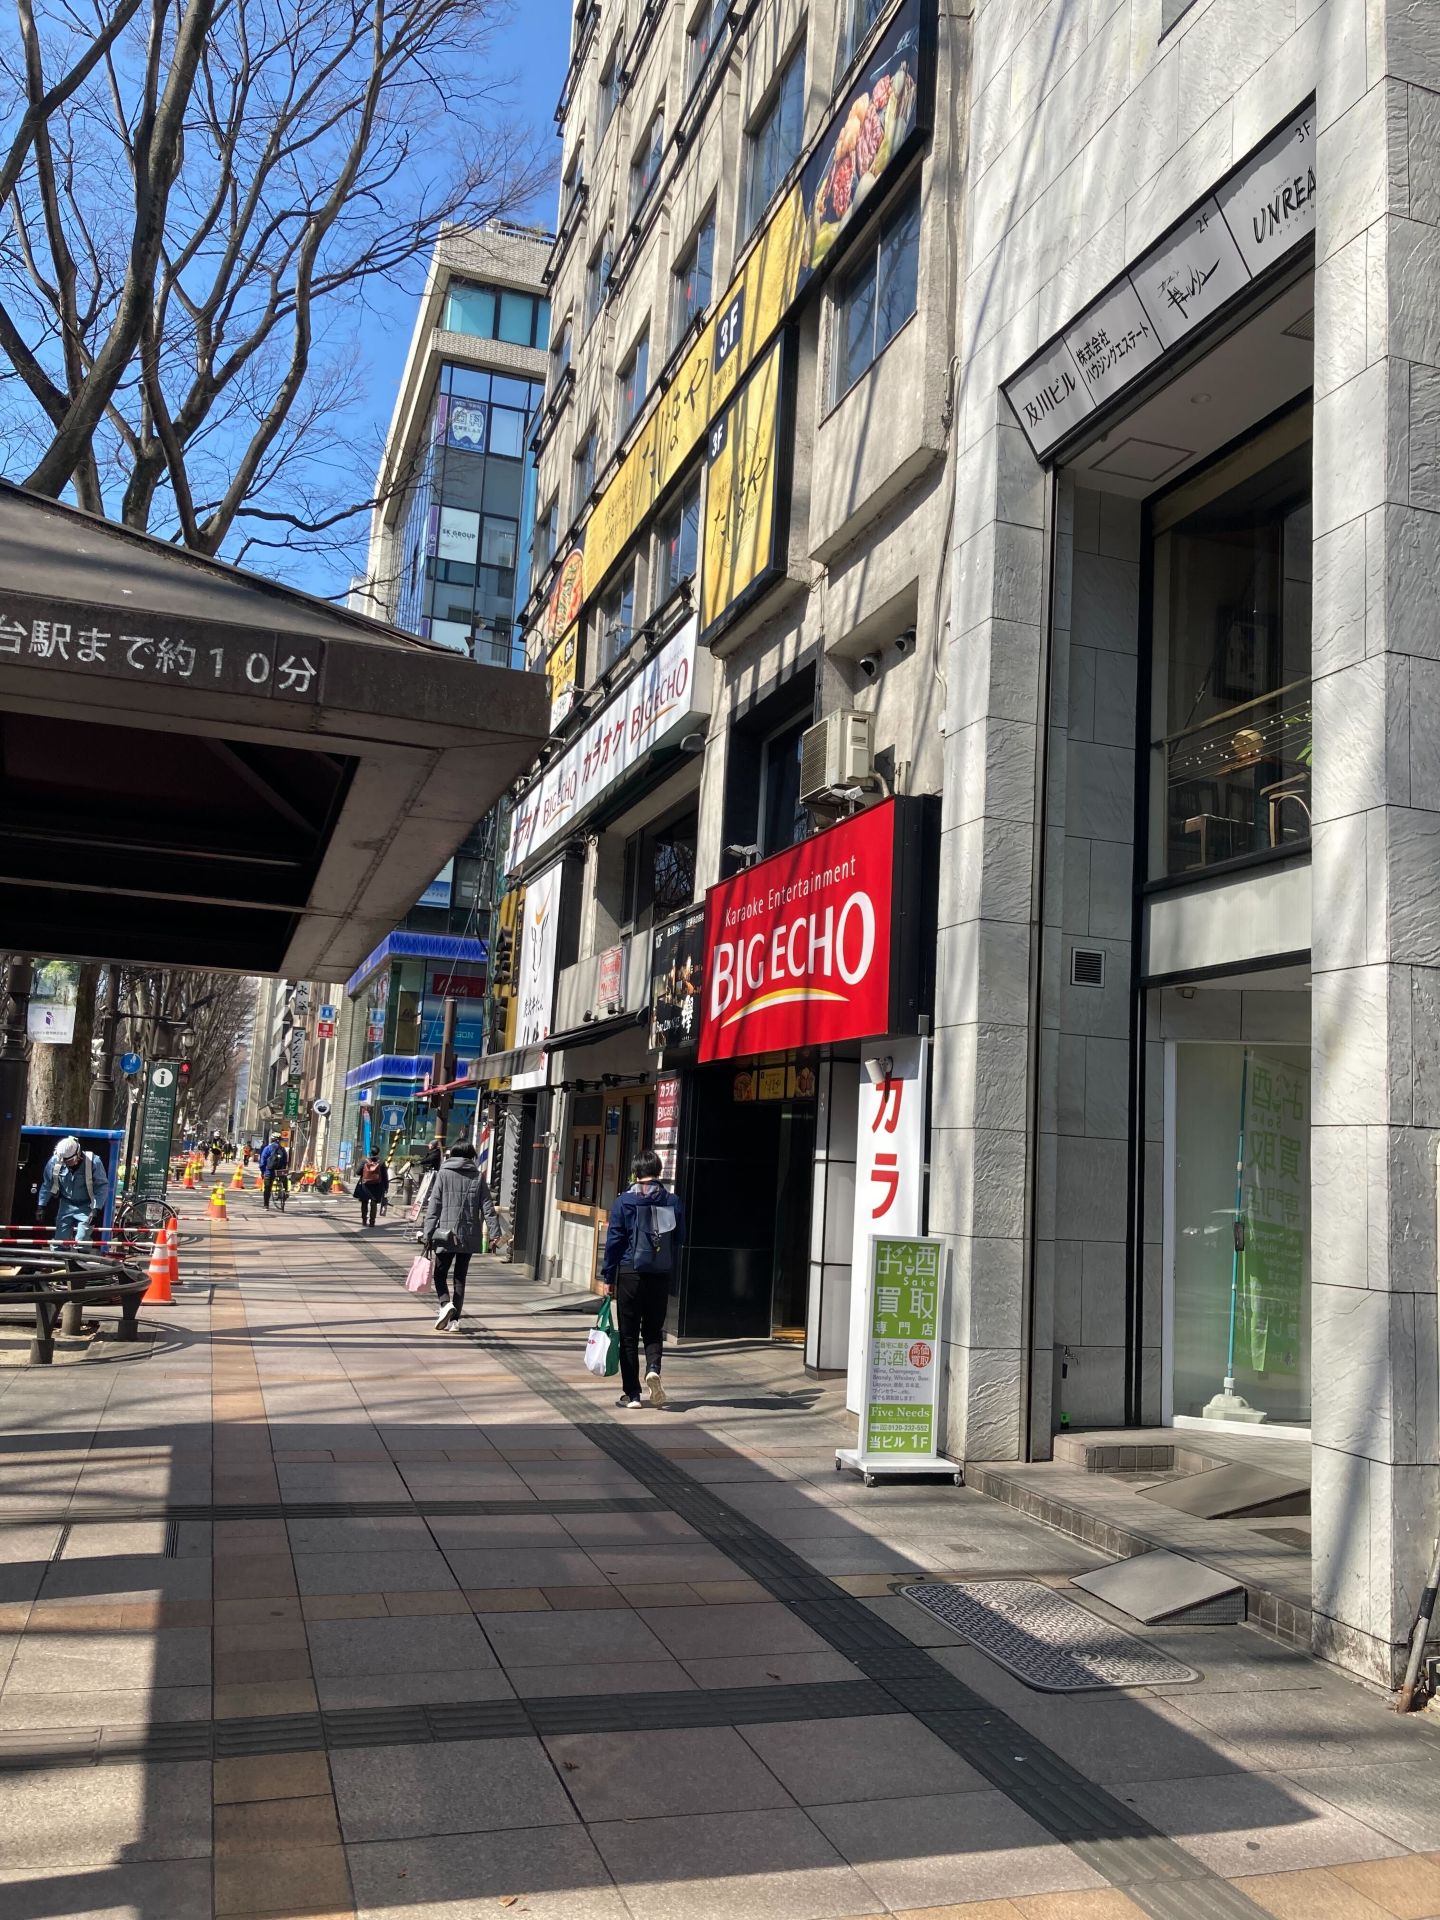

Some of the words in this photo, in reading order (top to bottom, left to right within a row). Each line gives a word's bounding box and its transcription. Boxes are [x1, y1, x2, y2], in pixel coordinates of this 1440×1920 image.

[1295, 119, 1311, 143] 3F
[1195, 212, 1210, 235] 2F
[718, 300, 741, 359] 3F
[1075, 329, 1110, 366] 株式会社
[1085, 321, 1151, 384] ハウジングエステート
[1022, 372, 1077, 428] 及川ビル
[454, 410, 482, 428] 歯科
[711, 423, 724, 457] 3F
[581, 718, 626, 788] カラオケ
[725, 896, 764, 928] Karaoke
[768, 854, 857, 912] Entertainment
[878, 1244, 937, 1277] お酒
[903, 1276, 936, 1287] Sake
[876, 1286, 935, 1319] 買取
[875, 1321, 934, 1336] 専門店
[871, 1406, 894, 1417] Five
[897, 1407, 930, 1418] Needs
[869, 1435, 905, 1449] 当ビル
[911, 1434, 929, 1449] 1F
